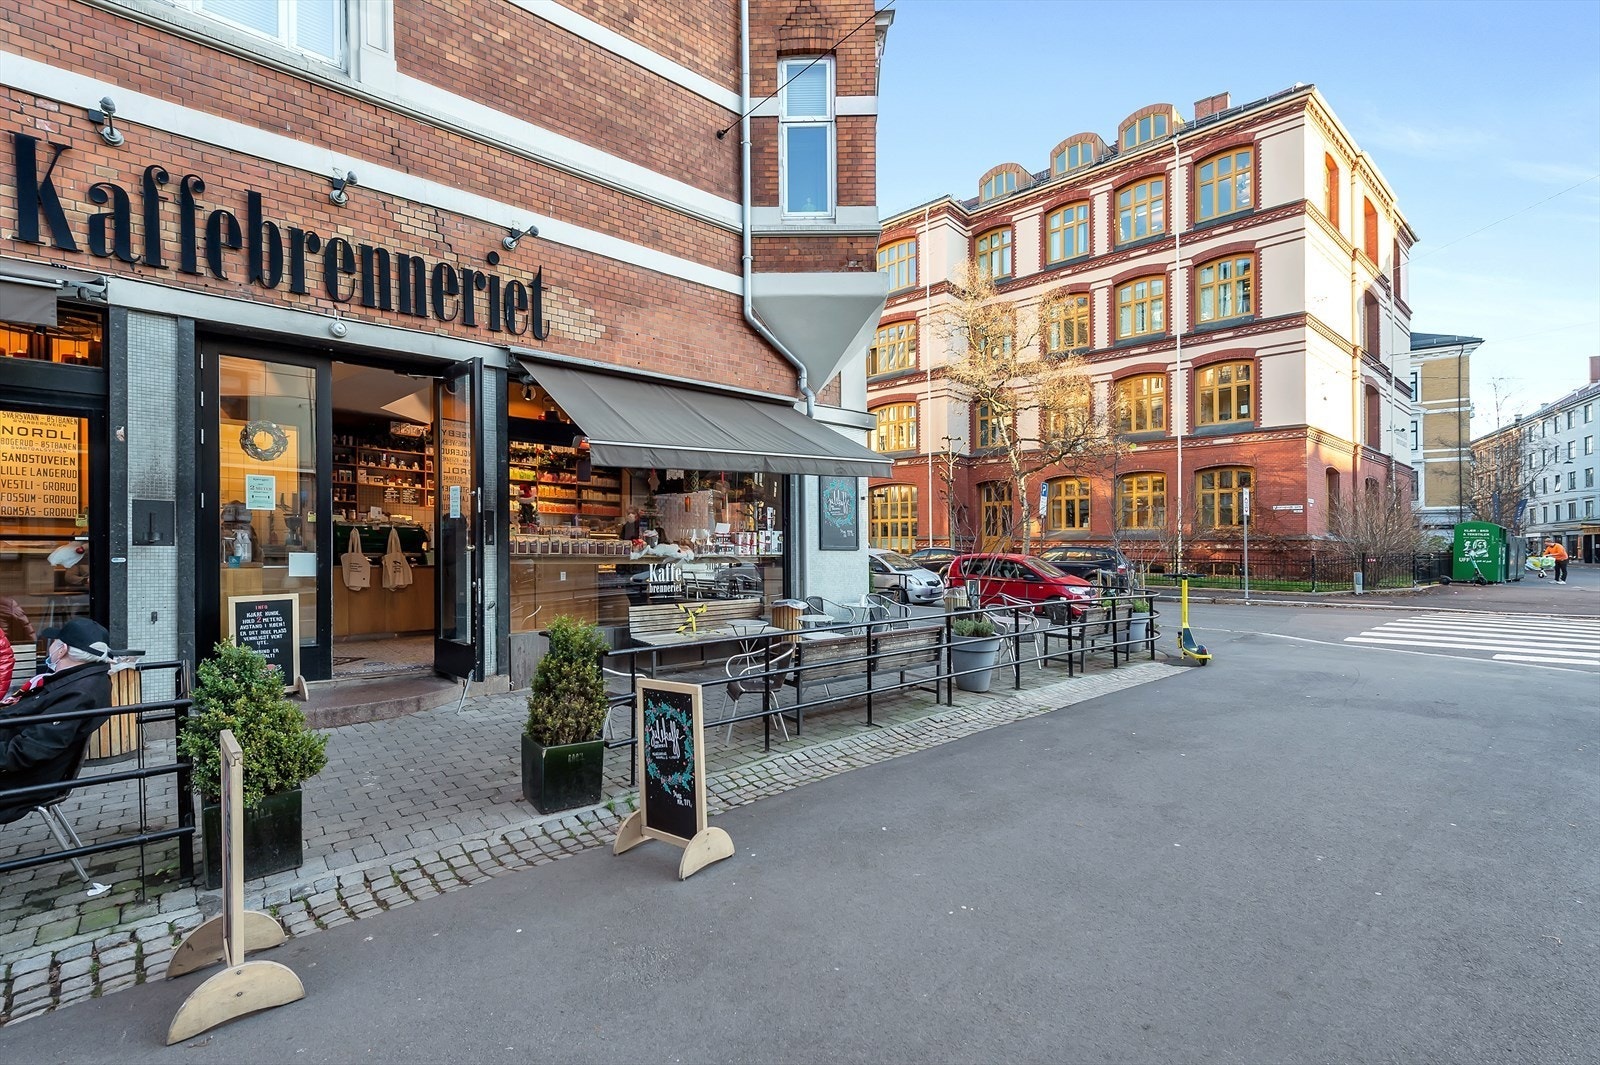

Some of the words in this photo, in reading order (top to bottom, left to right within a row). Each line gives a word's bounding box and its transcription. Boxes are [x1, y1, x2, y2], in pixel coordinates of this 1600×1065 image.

[7, 130, 550, 341] Kaffebrenneriet
[1, 425, 76, 441] NORDLI
[2, 453, 76, 466] SANDSTUVEIEN
[0, 465, 27, 476] LILLE
[30, 467, 77, 479] LANGERUD
[0, 479, 33, 490] VESTLI
[42, 481, 77, 492] GRORUD
[1042, 483, 1047, 495] P
[0, 492, 36, 503] FOSSUM
[43, 494, 77, 505] GRORUD
[0, 505, 36, 516] ROMSÅS
[43, 507, 77, 517] GRORUD
[649, 562, 682, 583] Kaffe
[649, 582, 682, 593] brenneriet
